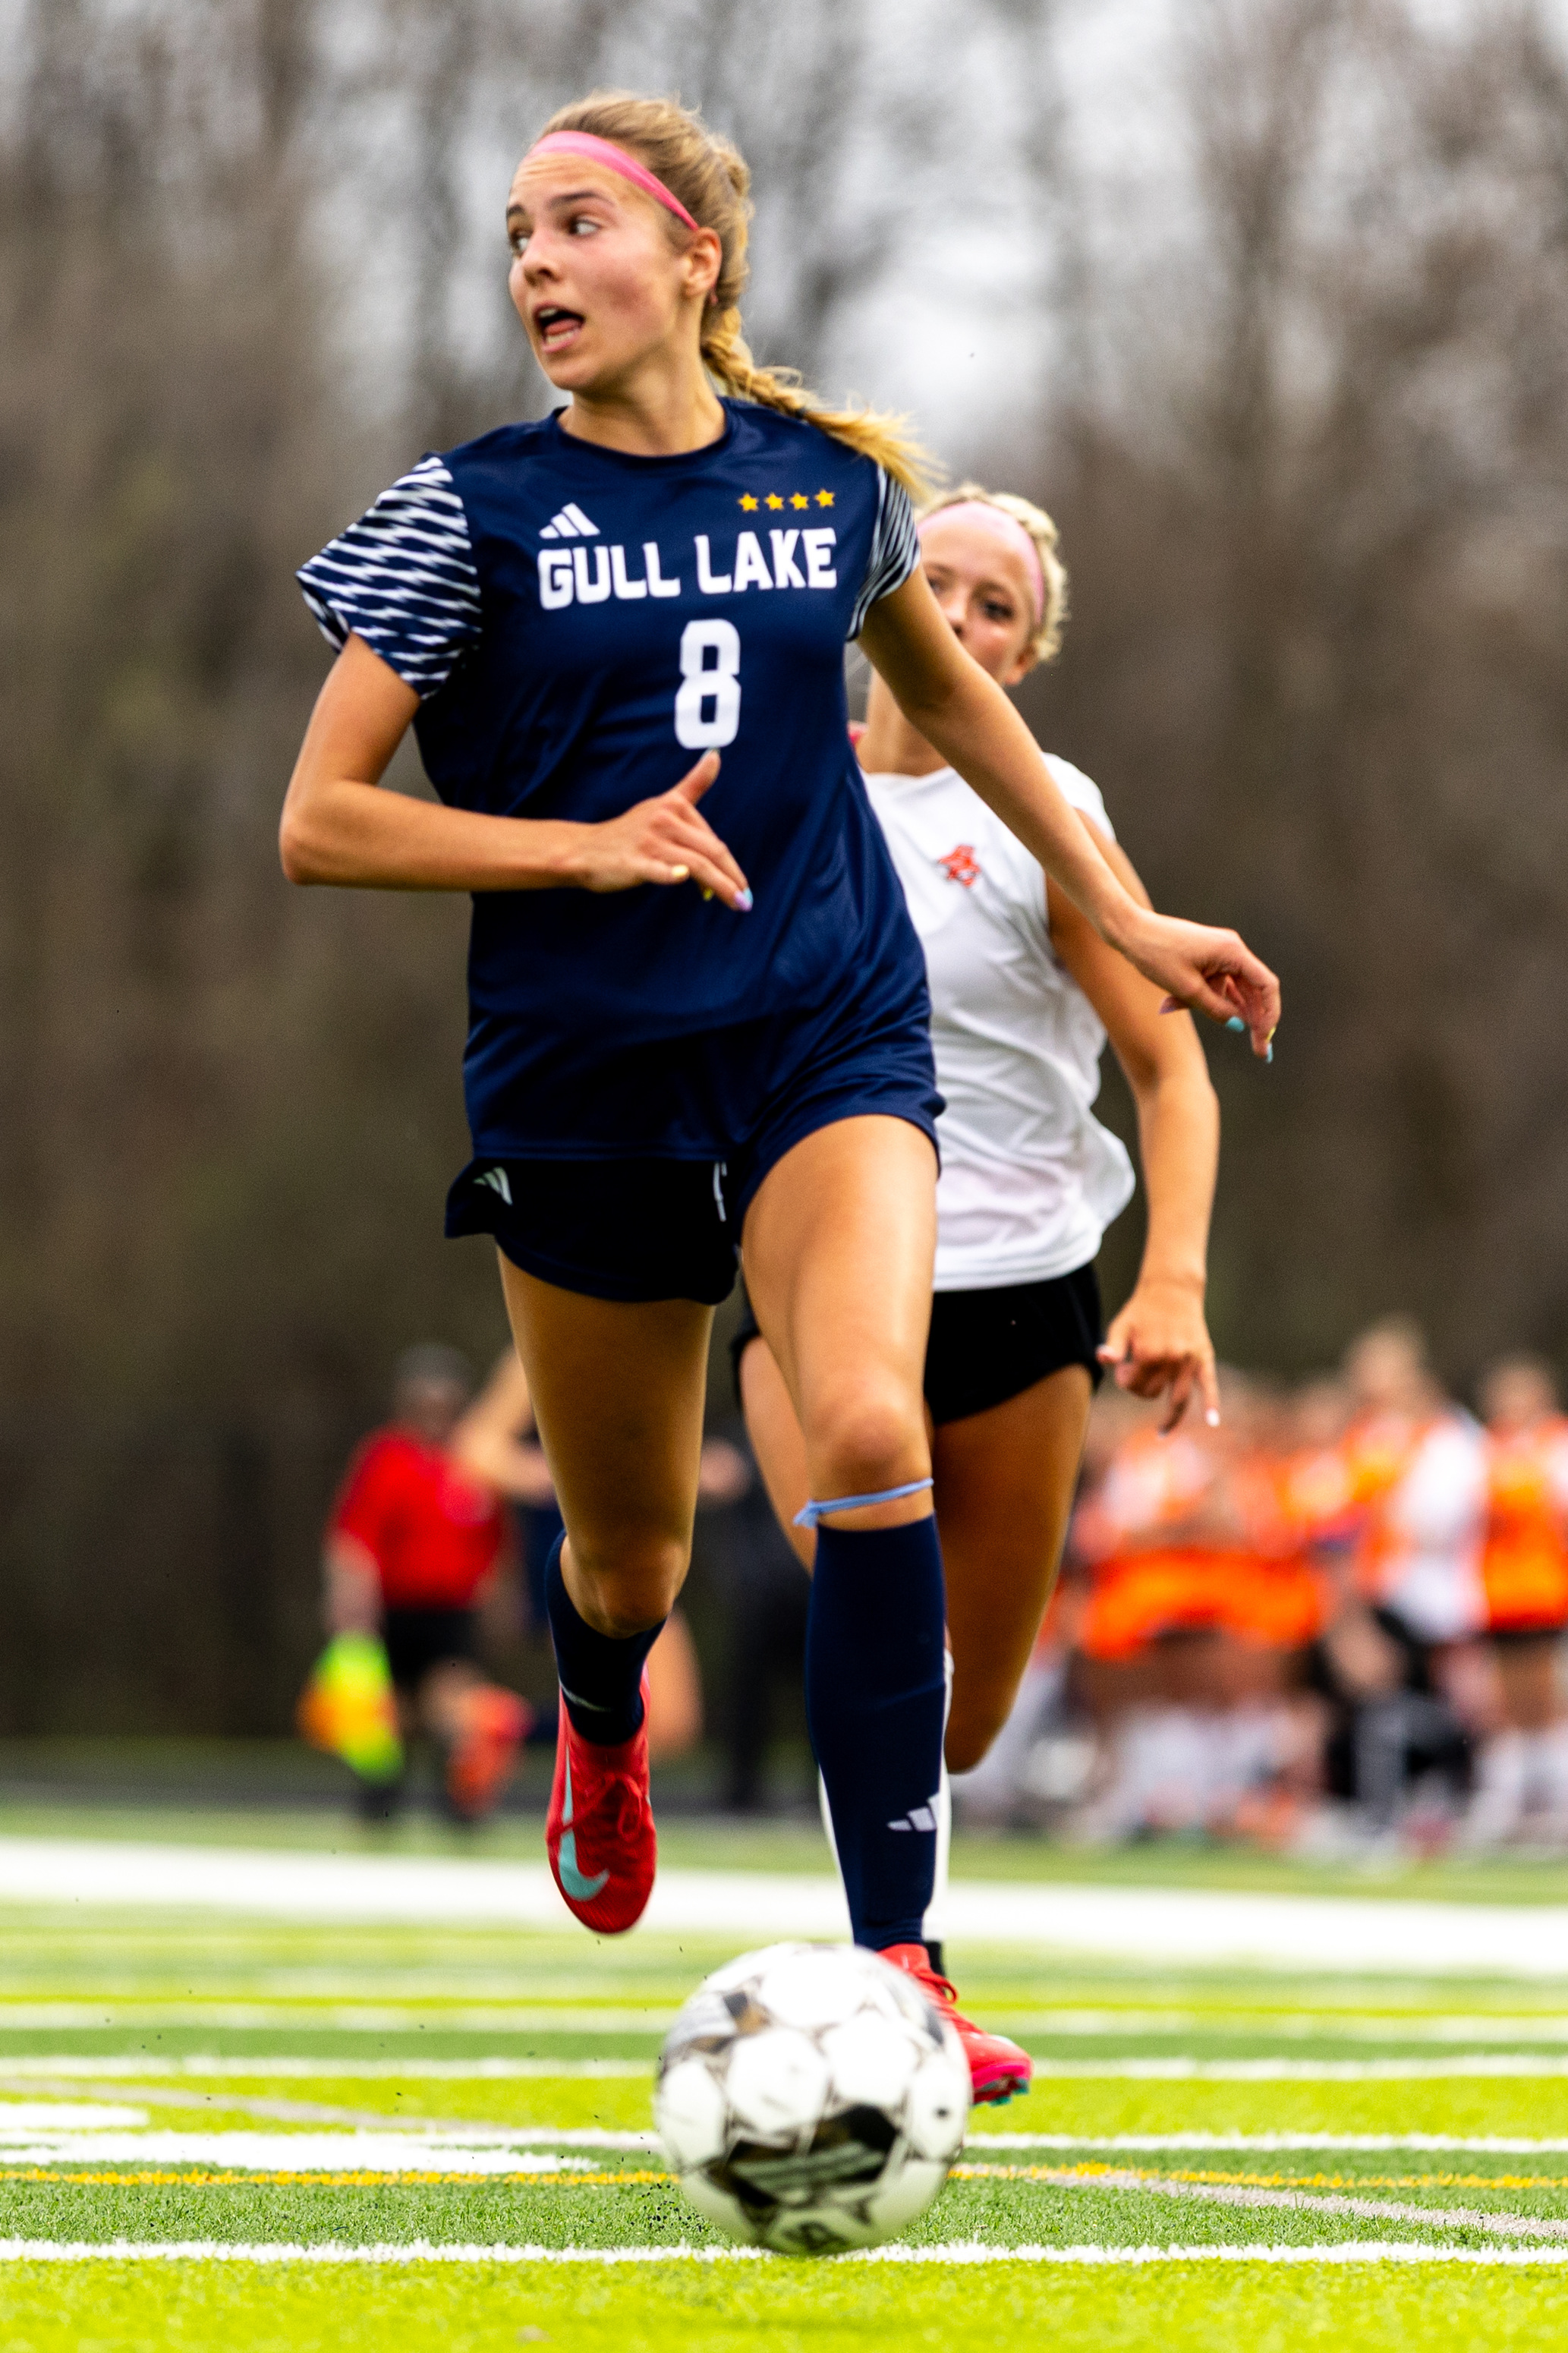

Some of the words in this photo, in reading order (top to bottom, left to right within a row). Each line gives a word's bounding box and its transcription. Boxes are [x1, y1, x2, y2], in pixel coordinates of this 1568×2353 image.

[537, 541, 682, 610] GULL
[694, 527, 837, 594] LAKE
[674, 619, 741, 750] 8
